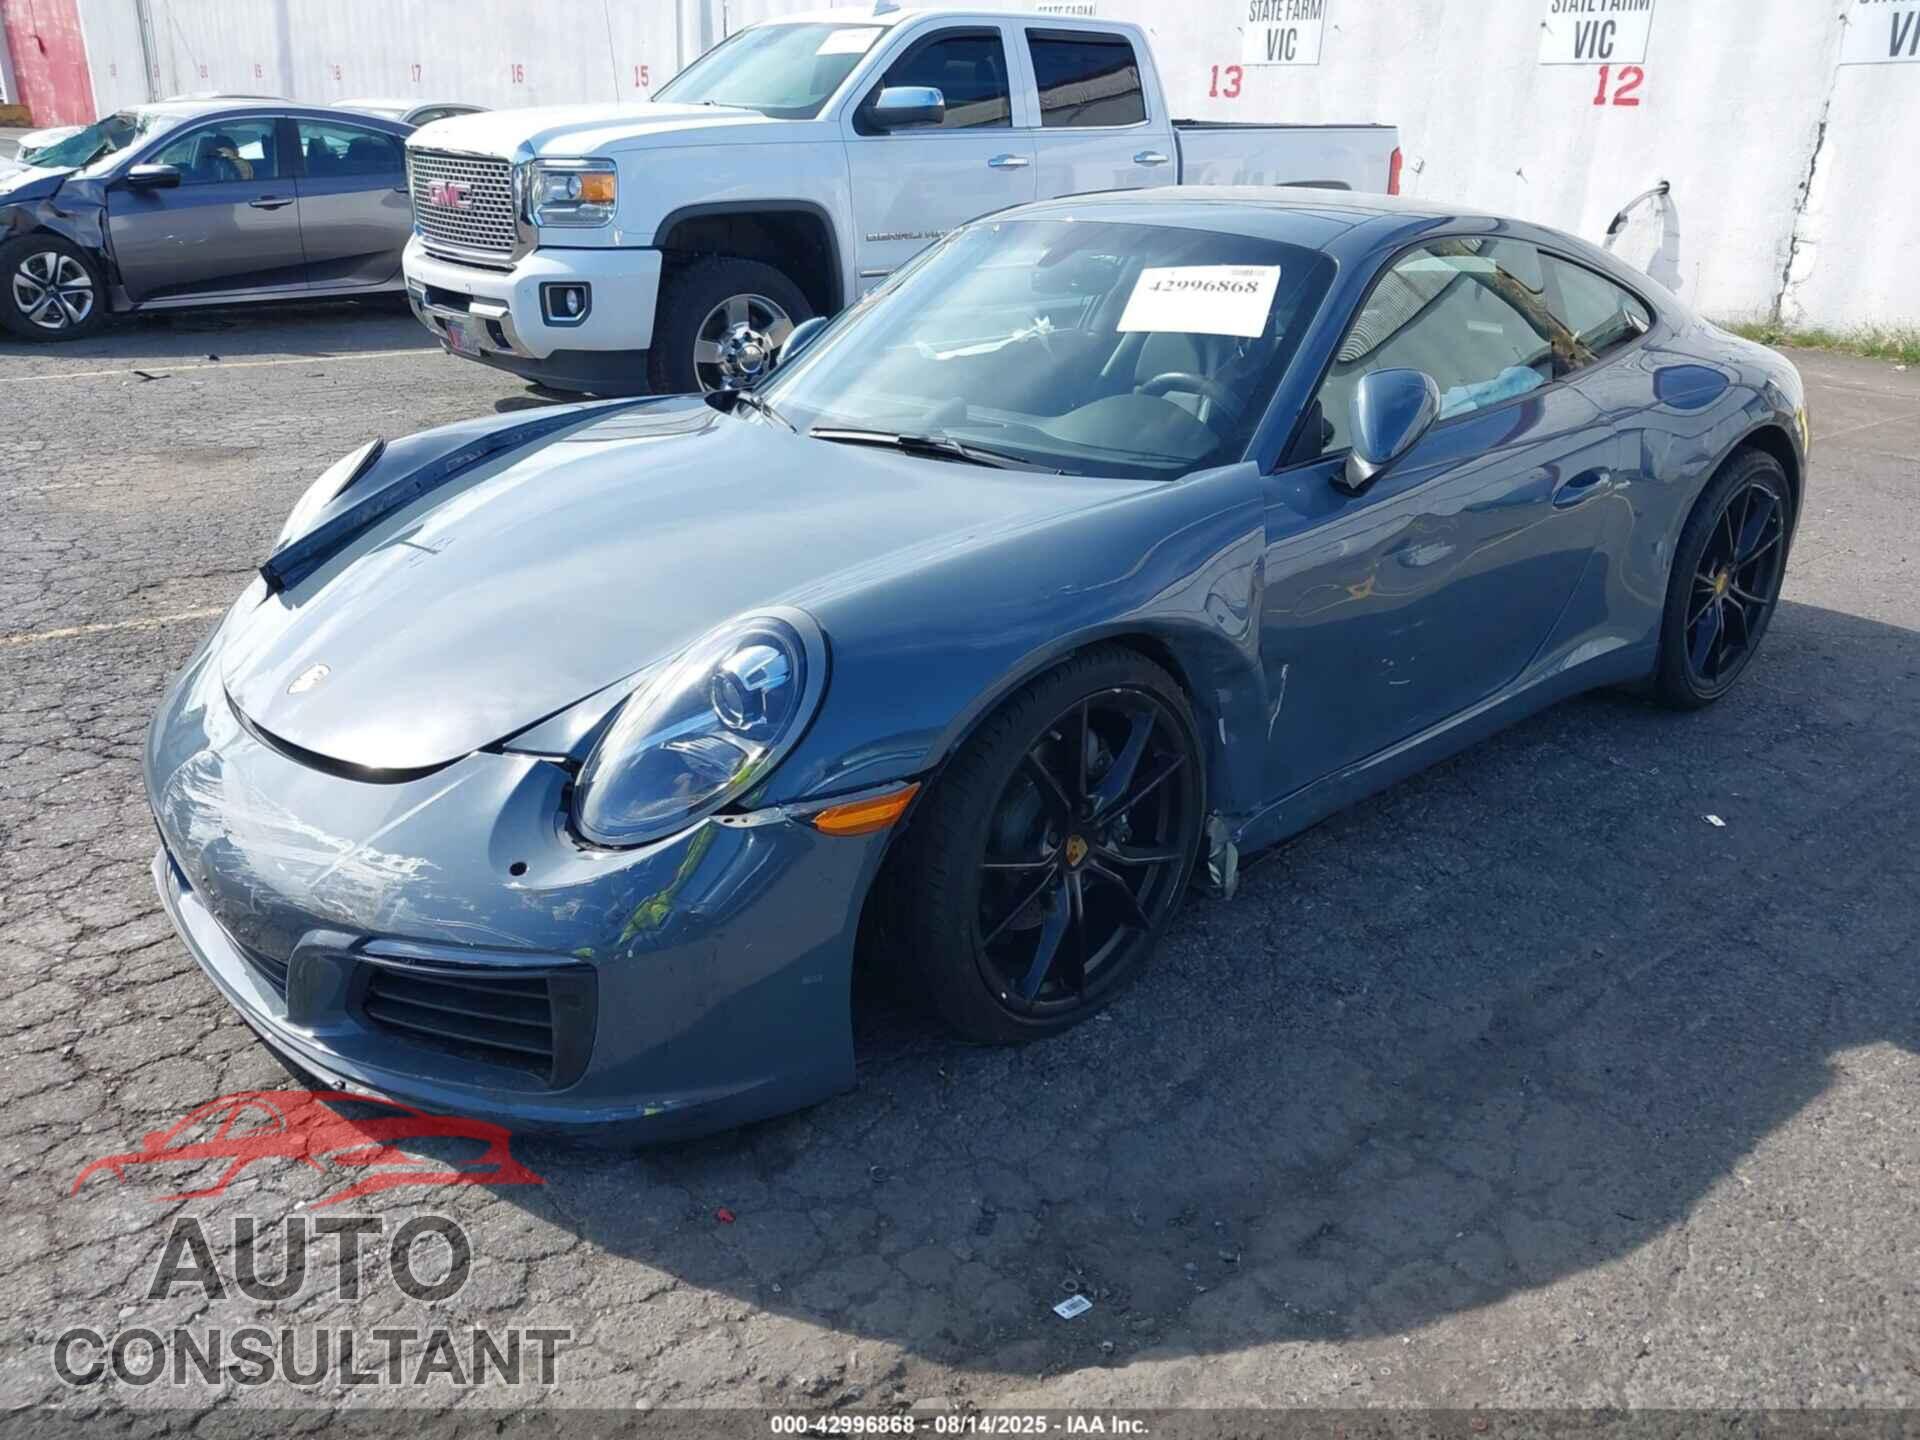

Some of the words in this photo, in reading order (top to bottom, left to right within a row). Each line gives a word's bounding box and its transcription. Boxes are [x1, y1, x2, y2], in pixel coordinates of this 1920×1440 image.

[1249, 0, 1283, 21] STATE
[1286, 0, 1322, 20] FARM
[1267, 28, 1297, 61] VIC
[1574, 19, 1616, 60] VIC
[411, 64, 422, 82] 17
[511, 64, 523, 83] 16
[633, 65, 648, 87] 15
[1209, 65, 1243, 98] 13
[1593, 65, 1644, 106] 12
[428, 181, 472, 208] GMC
[1149, 279, 1259, 294] 42996868
